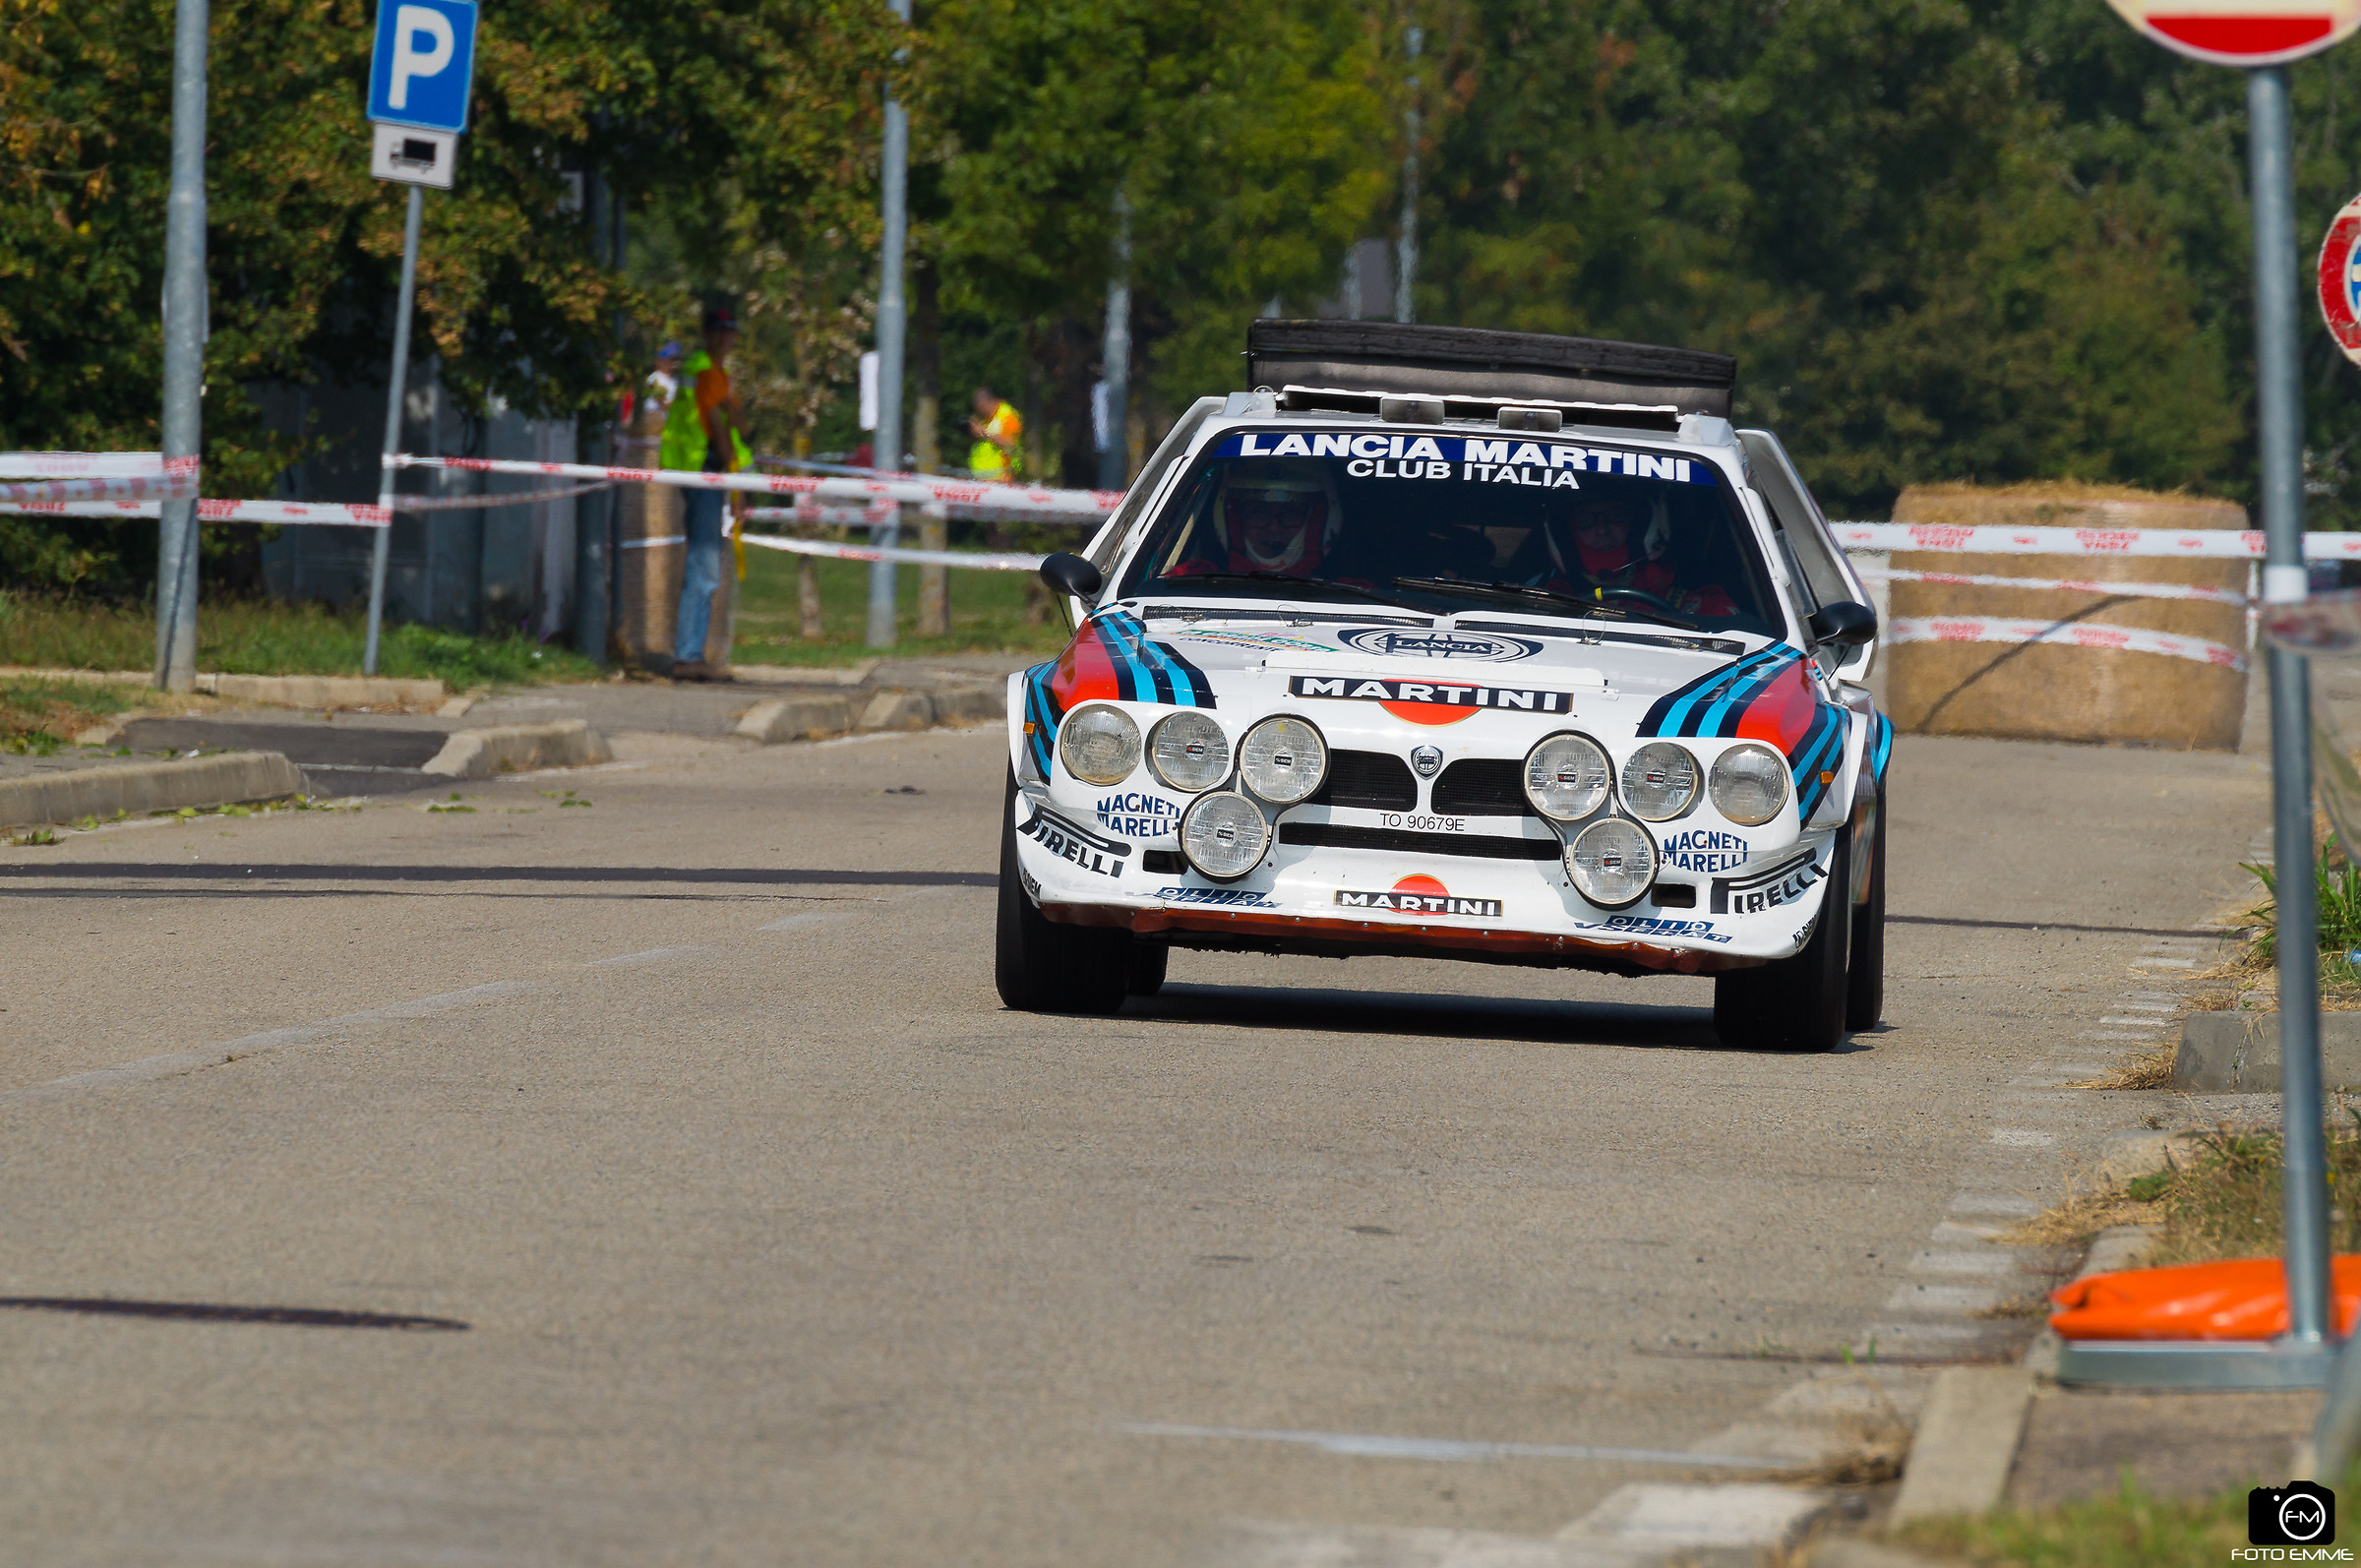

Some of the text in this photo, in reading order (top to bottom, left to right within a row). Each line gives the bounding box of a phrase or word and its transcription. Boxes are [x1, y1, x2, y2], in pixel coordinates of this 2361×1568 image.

[388, 4, 454, 110] P
[1240, 434, 1691, 482] LANCIA MARTINI
[1347, 459, 1580, 489] CLUB ITALIA
[1395, 639, 1489, 652] LANCIA
[1302, 678, 1558, 710] MARTINI
[1097, 793, 1180, 818] MAGNETI
[1380, 814, 1465, 832] TO 90679E
[1017, 803, 1131, 878] PIRELLI
[1664, 829, 1748, 853] MAGNETI
[1664, 851, 1747, 873] MARELLI
[1710, 847, 1829, 915] PIRELLI
[1164, 888, 1258, 901] OLIO
[1342, 893, 1495, 916] MARTINI
[1611, 917, 1710, 931] OLIO
